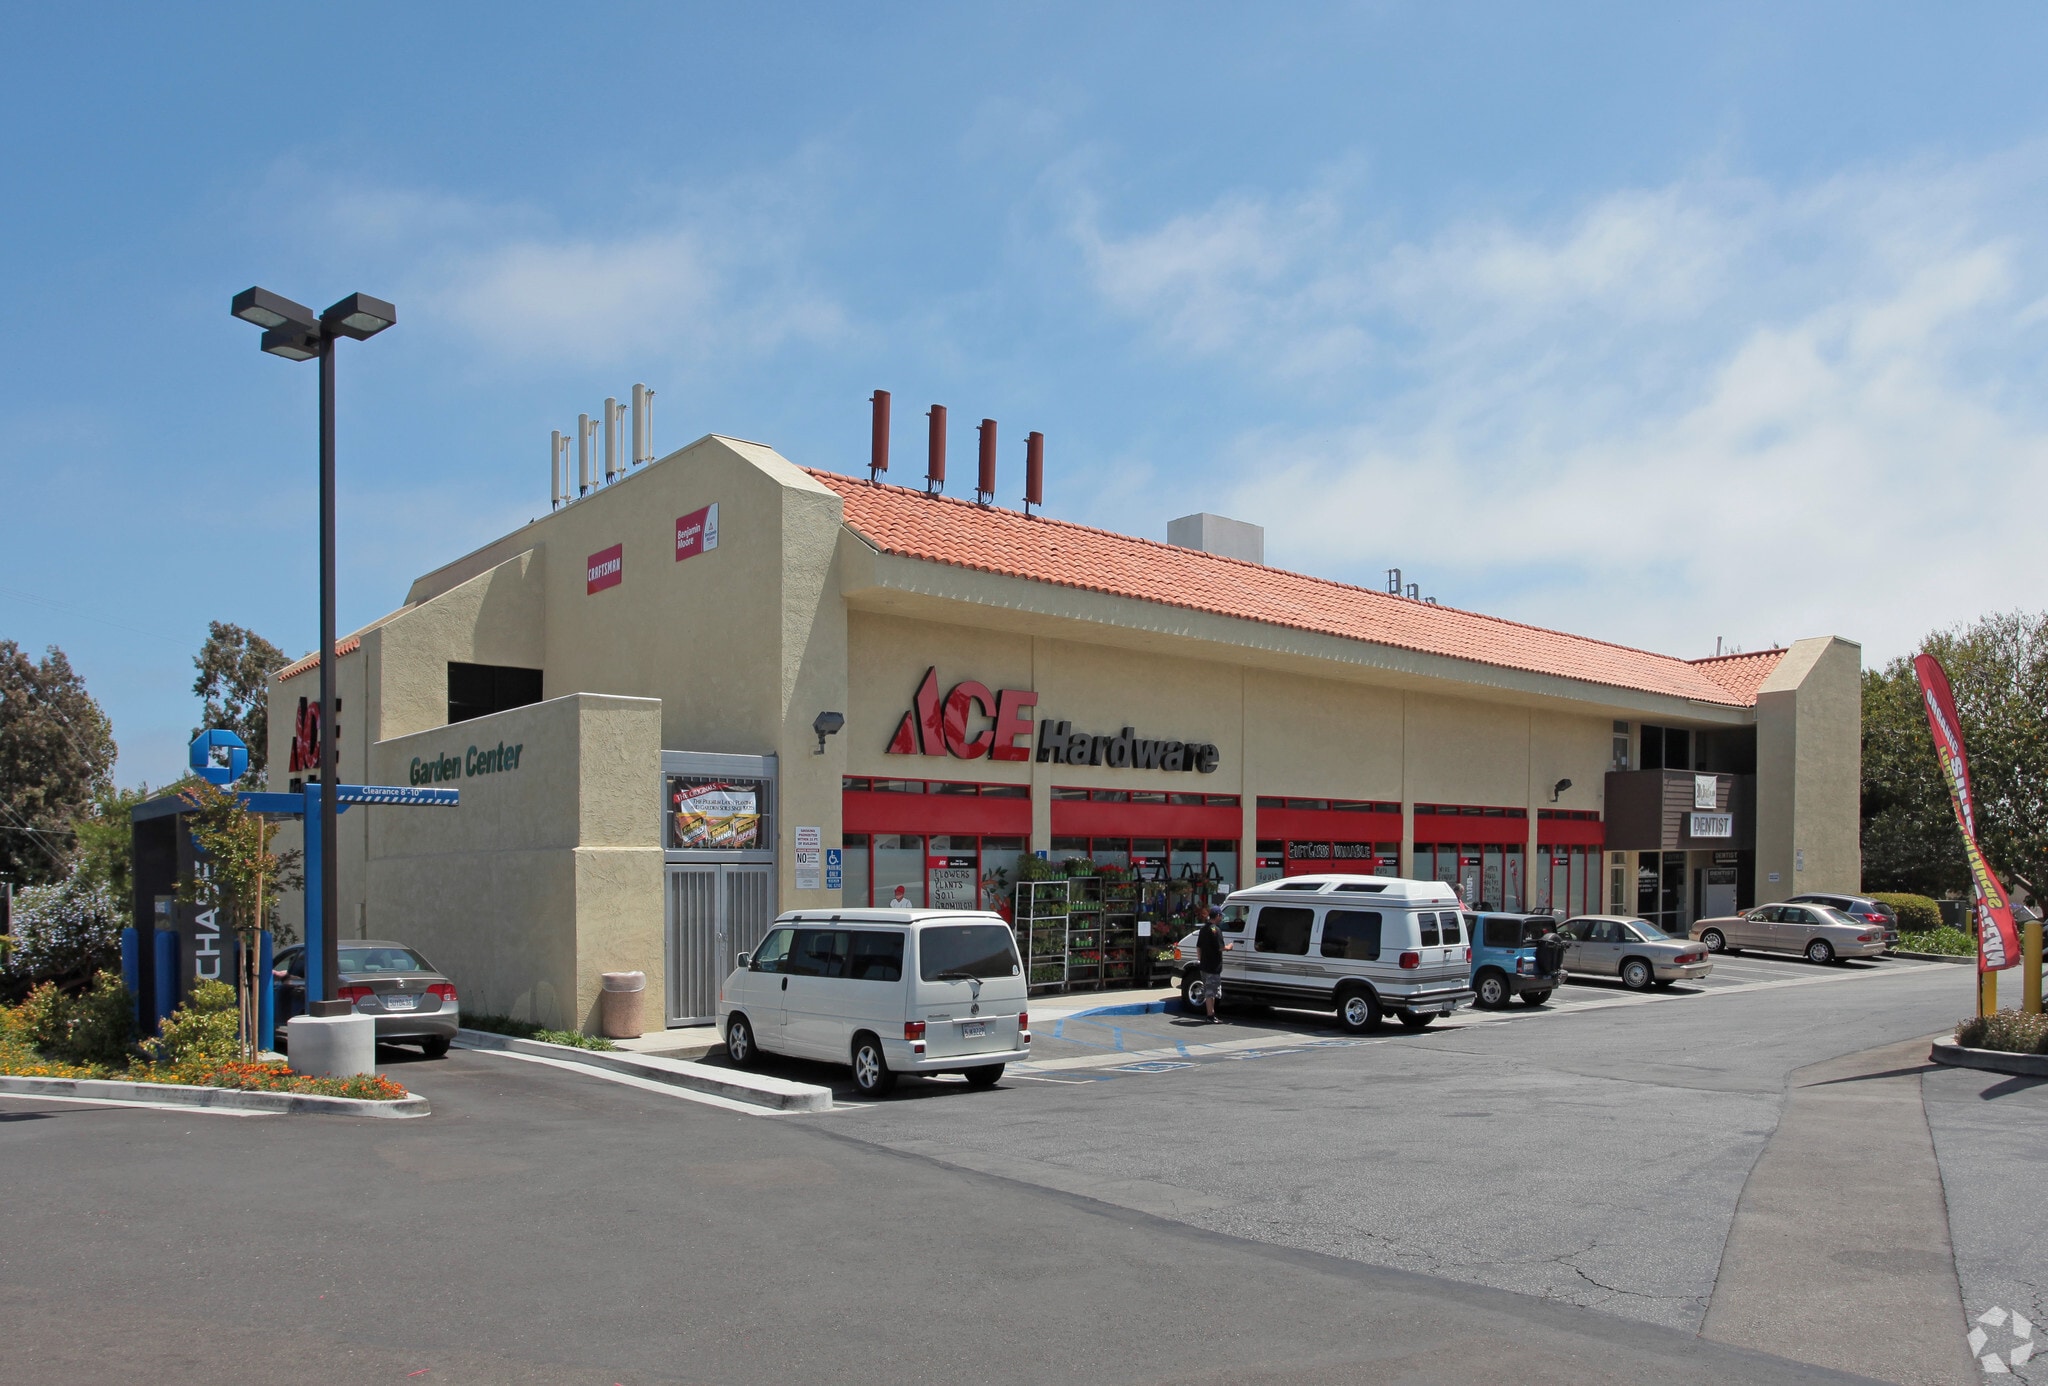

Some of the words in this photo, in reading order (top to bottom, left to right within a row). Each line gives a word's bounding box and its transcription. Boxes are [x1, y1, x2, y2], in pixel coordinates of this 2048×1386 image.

[678, 524, 701, 539] Benjamin
[678, 537, 694, 549] Moore
[588, 557, 621, 581] CRAFTSMAN
[886, 666, 1039, 763] ACE
[1036, 718, 1220, 773] Hardware
[409, 752, 462, 786] Garden
[465, 741, 523, 778] Center
[362, 786, 399, 797] Clearance
[1693, 816, 1729, 834] DENTIST
[797, 853, 807, 864] NO
[1715, 851, 1738, 859] DENTIST
[934, 869, 970, 879] FLOWERS
[934, 878, 963, 889] PLANTS
